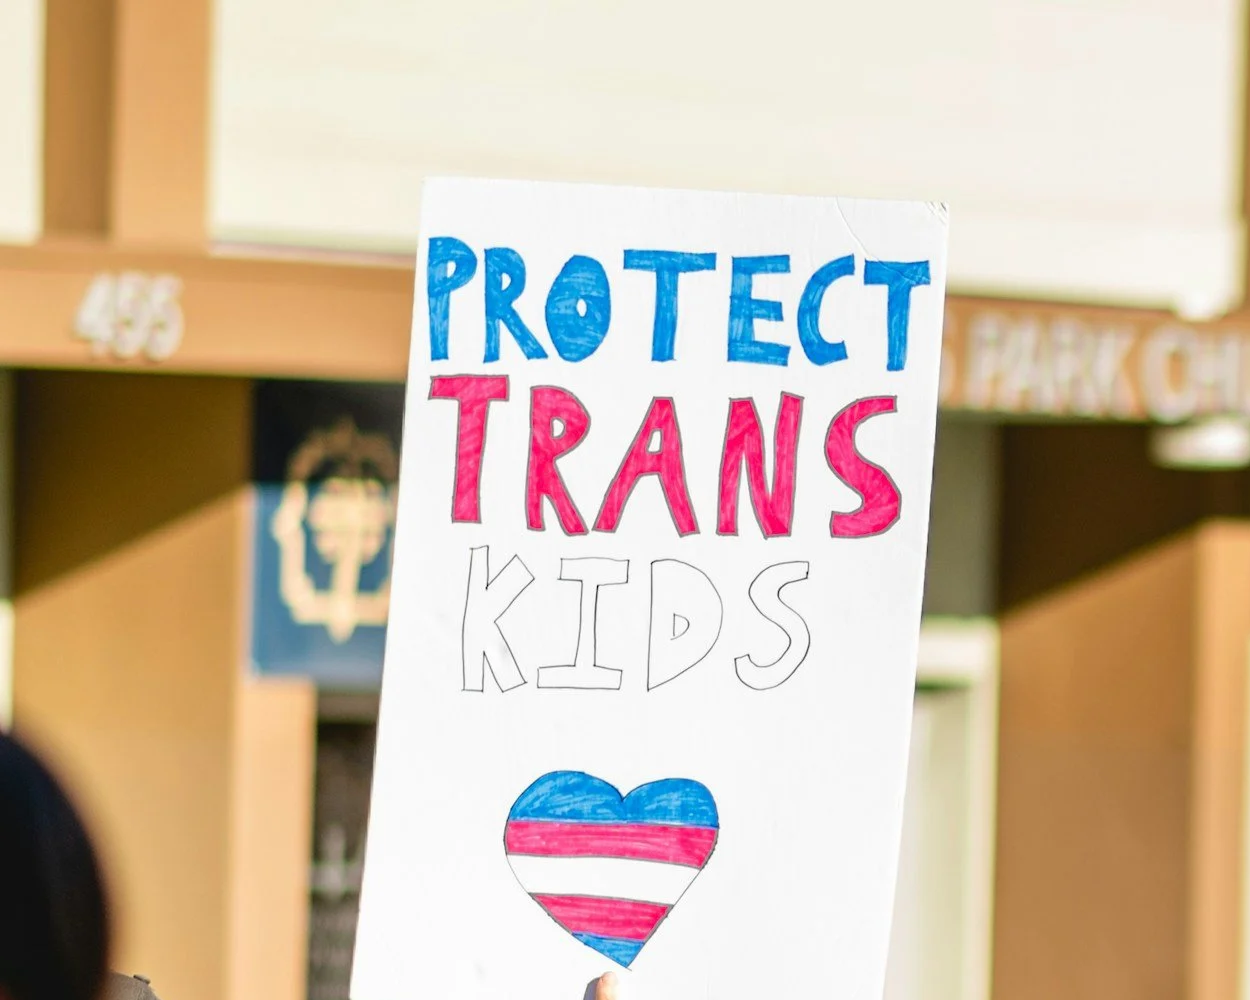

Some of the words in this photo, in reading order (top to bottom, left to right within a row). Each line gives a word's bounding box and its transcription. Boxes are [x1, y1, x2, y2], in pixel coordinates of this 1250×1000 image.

[427, 236, 931, 371] PROTECT
[966, 310, 1138, 418] PARK
[429, 374, 902, 539] TRANS
[461, 545, 810, 692] KIDS
